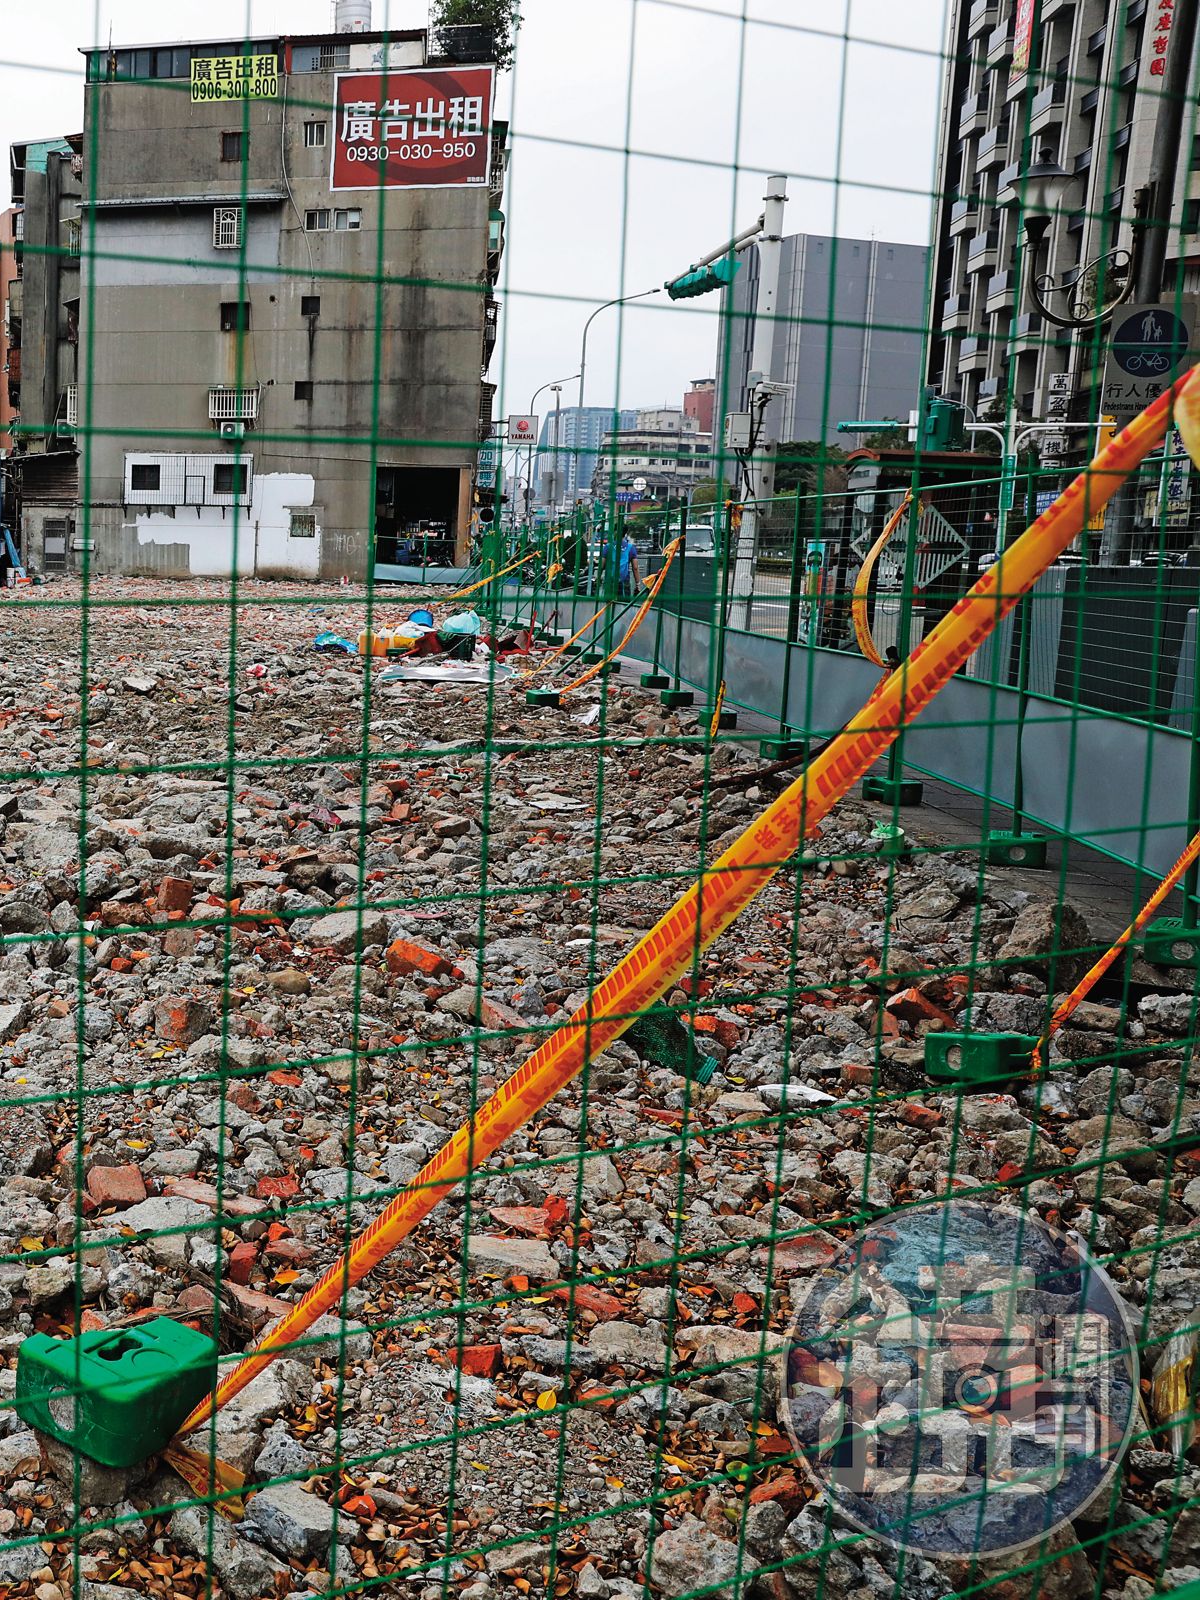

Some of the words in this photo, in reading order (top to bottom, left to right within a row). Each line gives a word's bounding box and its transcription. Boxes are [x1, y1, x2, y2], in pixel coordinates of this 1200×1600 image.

[193, 57, 276, 81] 廣告出租
[192, 78, 277, 100] 0906-300-800
[340, 96, 484, 143] 廣告出租
[346, 142, 476, 162] 0930-030-950
[1106, 383, 1166, 398] 行人優
[744, 791, 818, 864] 安全第一
